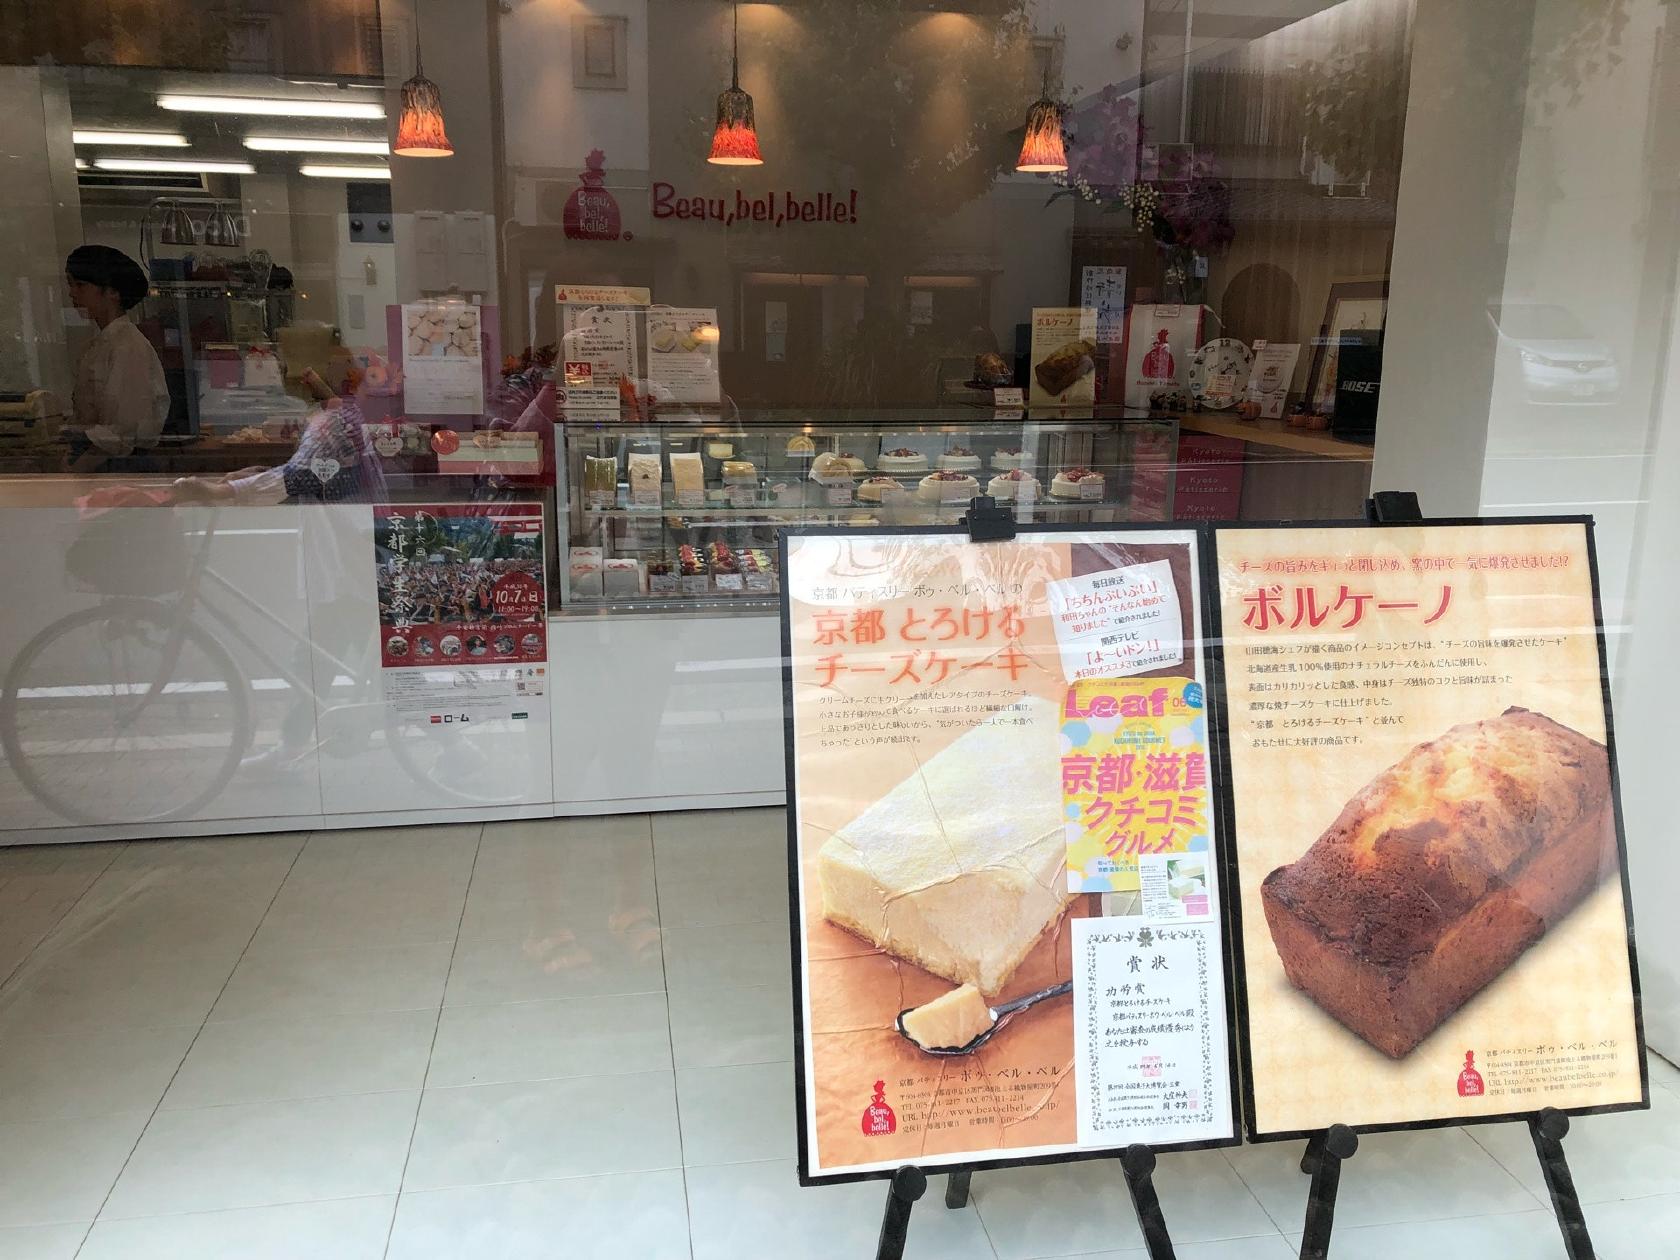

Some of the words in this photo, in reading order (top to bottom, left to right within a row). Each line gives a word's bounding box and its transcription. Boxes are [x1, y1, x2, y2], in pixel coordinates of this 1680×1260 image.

[577, 190, 610, 207] Beau,
[653, 182, 858, 227] Beau,bel,belle!
[1341, 380, 1380, 394] BOSE
[386, 512, 415, 634] 京都学生祭典
[812, 609, 886, 646] 京都
[899, 605, 1026, 642] とろける
[1243, 585, 1452, 630] ボルケーノ
[815, 648, 1029, 688] チーズケーキ
[1065, 687, 1169, 718] Leaf
[1061, 752, 1207, 795] 京都・滋賀
[1085, 795, 1198, 830] クチコミ
[1105, 828, 1176, 858] グルメ
[1127, 955, 1169, 973] 賞状
